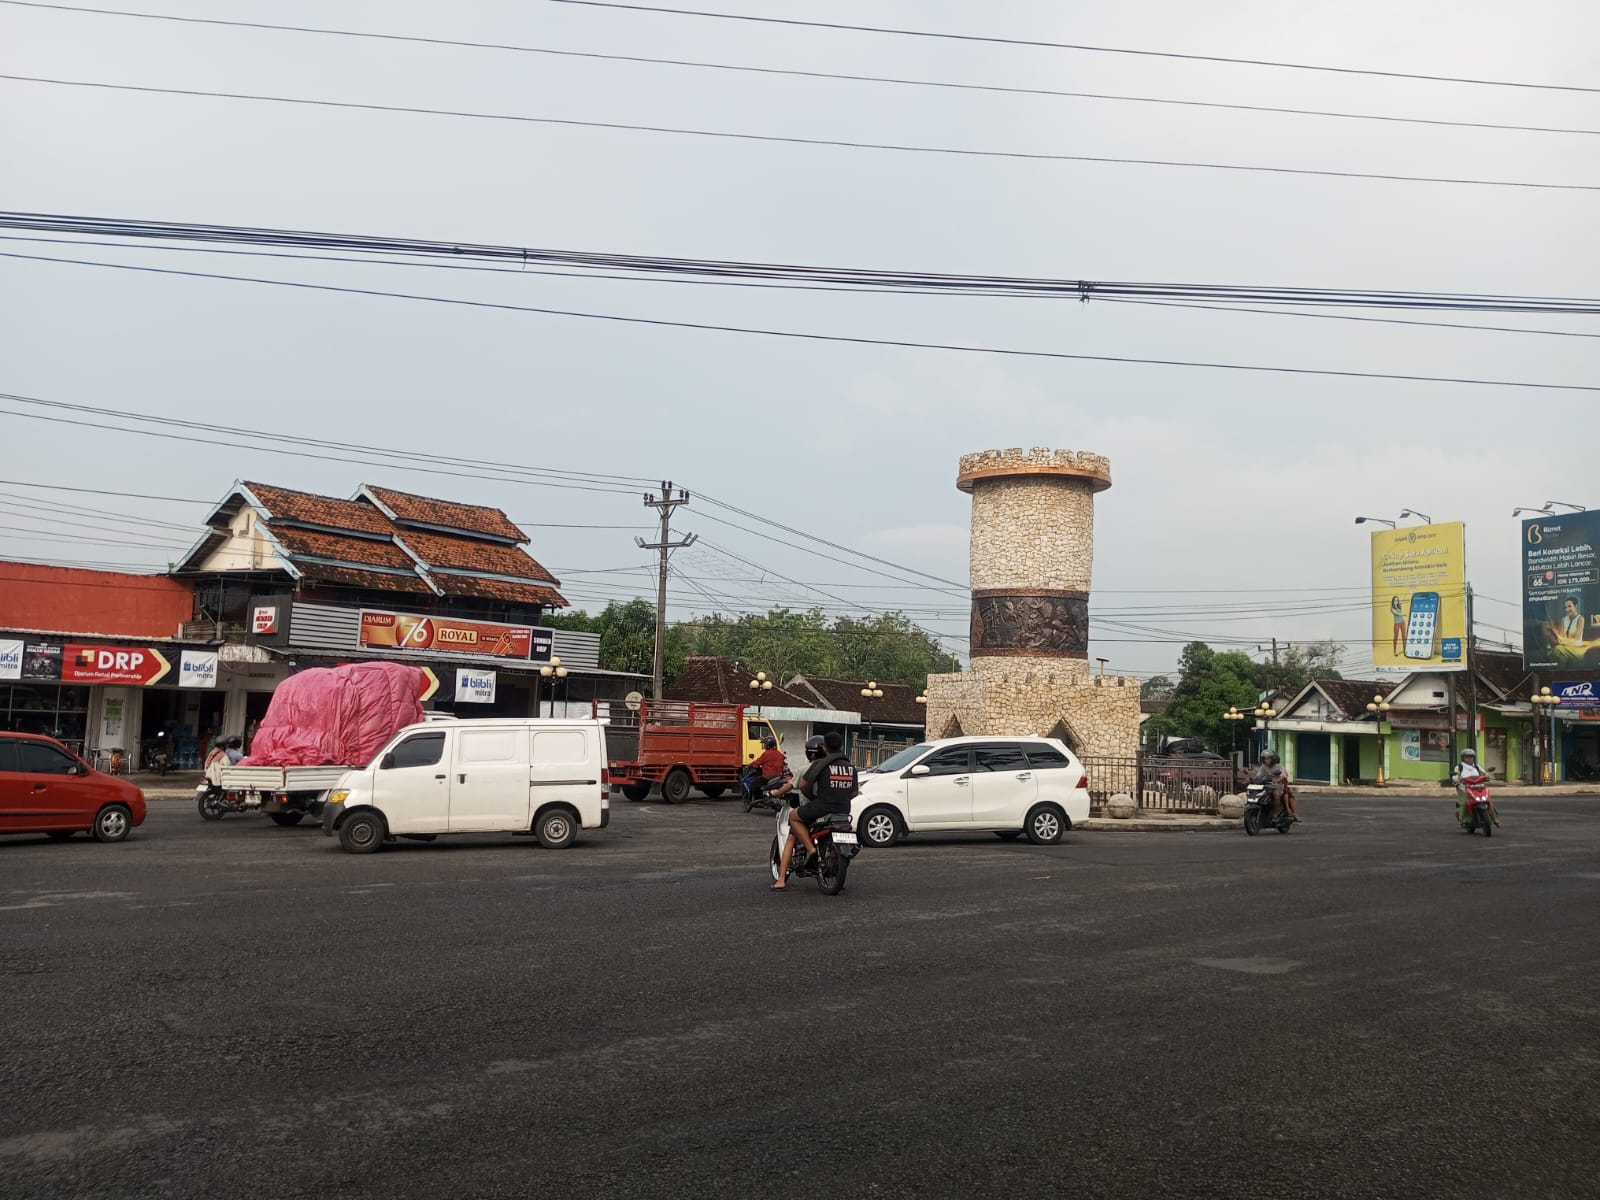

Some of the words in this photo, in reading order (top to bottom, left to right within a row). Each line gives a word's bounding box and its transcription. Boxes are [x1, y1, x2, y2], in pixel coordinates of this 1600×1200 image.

[1543, 525, 1561, 533] Biznet
[1528, 549, 1541, 557] Beri
[1543, 546, 1569, 556] Koneksi
[1571, 544, 1592, 553] Lebih.
[1553, 561, 1569, 569] Lebih
[1533, 579, 1543, 587] 65
[364, 615, 392, 624] DJARUM
[401, 618, 428, 647] 76
[440, 630, 475, 642] ROYAL
[0, 653, 18, 663] libli
[98, 651, 144, 671] DRP
[192, 663, 214, 672] blibli
[111, 672, 142, 680] Partnership
[470, 677, 491, 688] blibli
[829, 764, 853, 776] WILD
